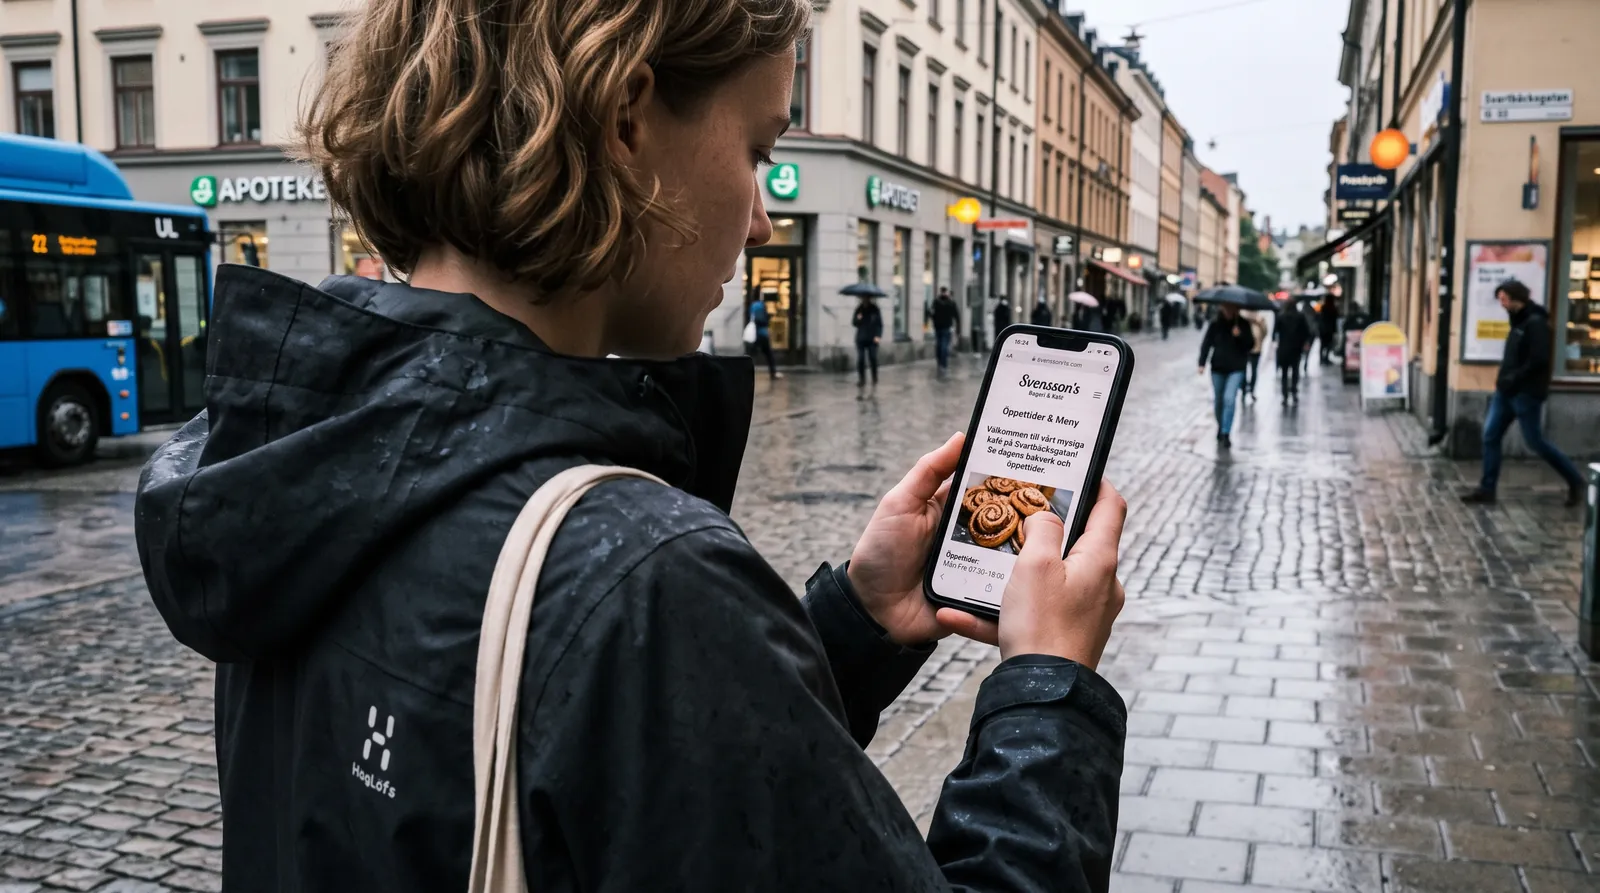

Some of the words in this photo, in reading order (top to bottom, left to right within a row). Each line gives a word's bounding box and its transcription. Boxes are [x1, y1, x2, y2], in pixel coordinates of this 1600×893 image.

[154, 217, 179, 238] UL
[1019, 374, 1080, 395] Svensson's
[1028, 390, 1046, 398] Bageri
[1002, 405, 1046, 421] Öppettider
[1046, 414, 1054, 423] &
[1055, 415, 1080, 428] Meny
[987, 435, 1003, 445] kafé
[1003, 438, 1013, 447] på
[1030, 432, 1040, 441] till
[1057, 438, 1085, 450] mysiga
[987, 446, 997, 454] Se
[998, 447, 1024, 459] dagens
[1025, 452, 1056, 465] bakverk
[1056, 459, 1071, 468] och
[1006, 460, 1046, 474] öppettider.
[945, 550, 980, 564] Öppettider:
[957, 564, 968, 572] Fre
